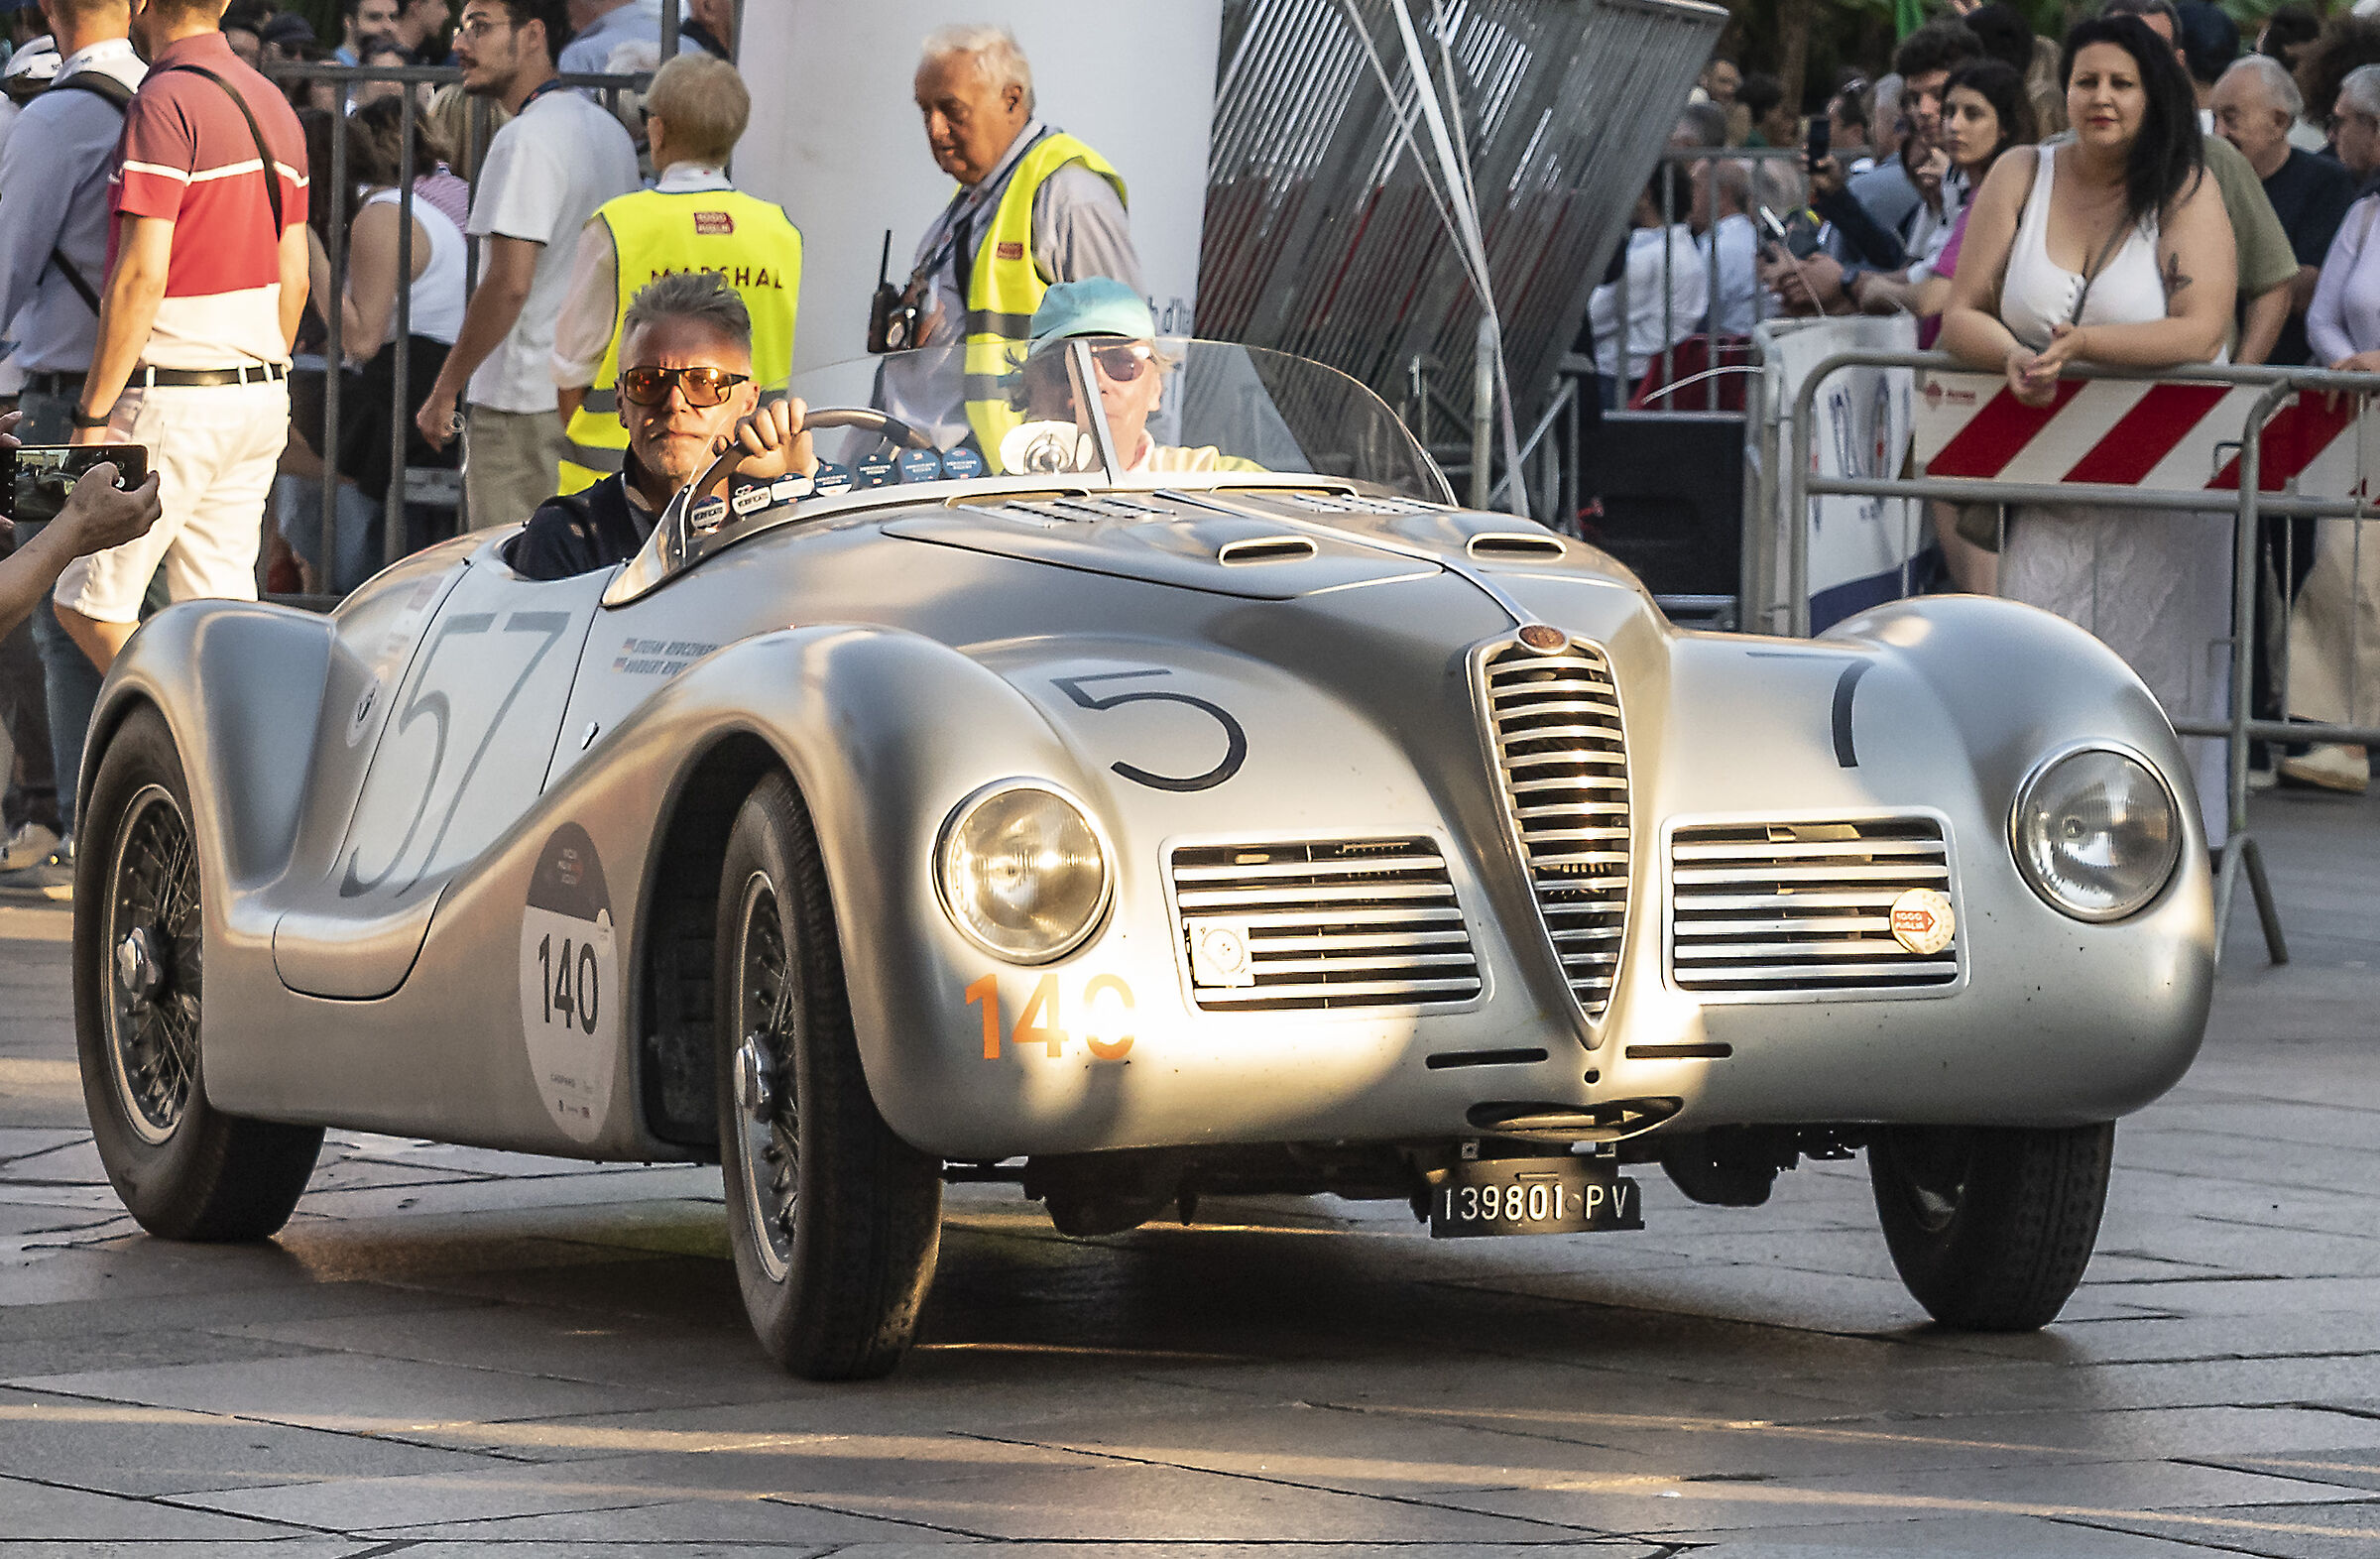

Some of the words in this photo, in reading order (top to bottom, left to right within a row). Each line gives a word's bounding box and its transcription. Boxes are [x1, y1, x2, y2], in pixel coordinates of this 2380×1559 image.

[339, 611, 572, 898] 57
[1049, 668, 1248, 792] 5
[538, 932, 599, 1036] 140
[964, 973, 1135, 1060] 140
[1445, 1183, 1564, 1221] 139801
